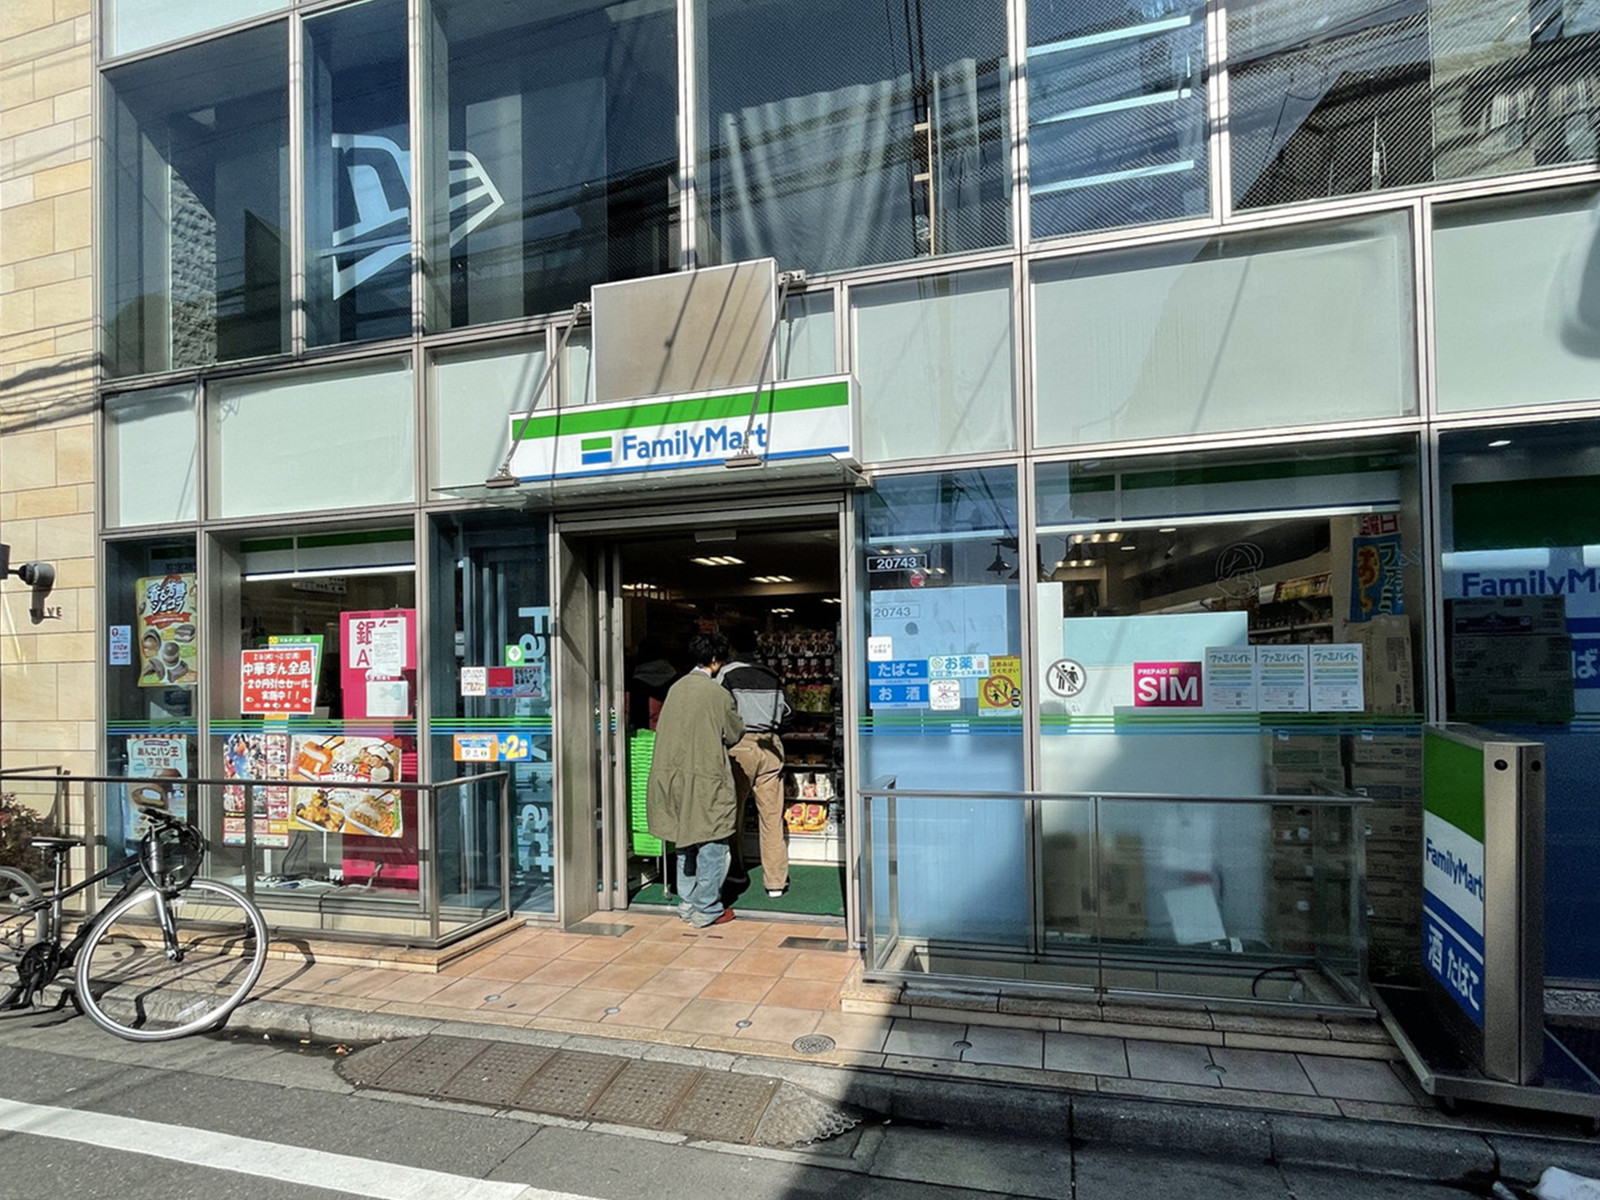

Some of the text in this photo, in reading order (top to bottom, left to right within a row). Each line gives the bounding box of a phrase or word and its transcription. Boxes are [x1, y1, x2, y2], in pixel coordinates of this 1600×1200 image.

[877, 557, 917, 569] 20743
[1378, 542, 1399, 613] ファミ
[1462, 568, 1600, 597] FamilyM
[873, 607, 911, 618] 20743
[243, 661, 311, 676] 中華まん全品
[878, 663, 919, 677] たばこ
[1138, 676, 1198, 702] SIM
[1426, 837, 1484, 902] FamilyMart
[1429, 924, 1480, 1011] 酒 たばこ
